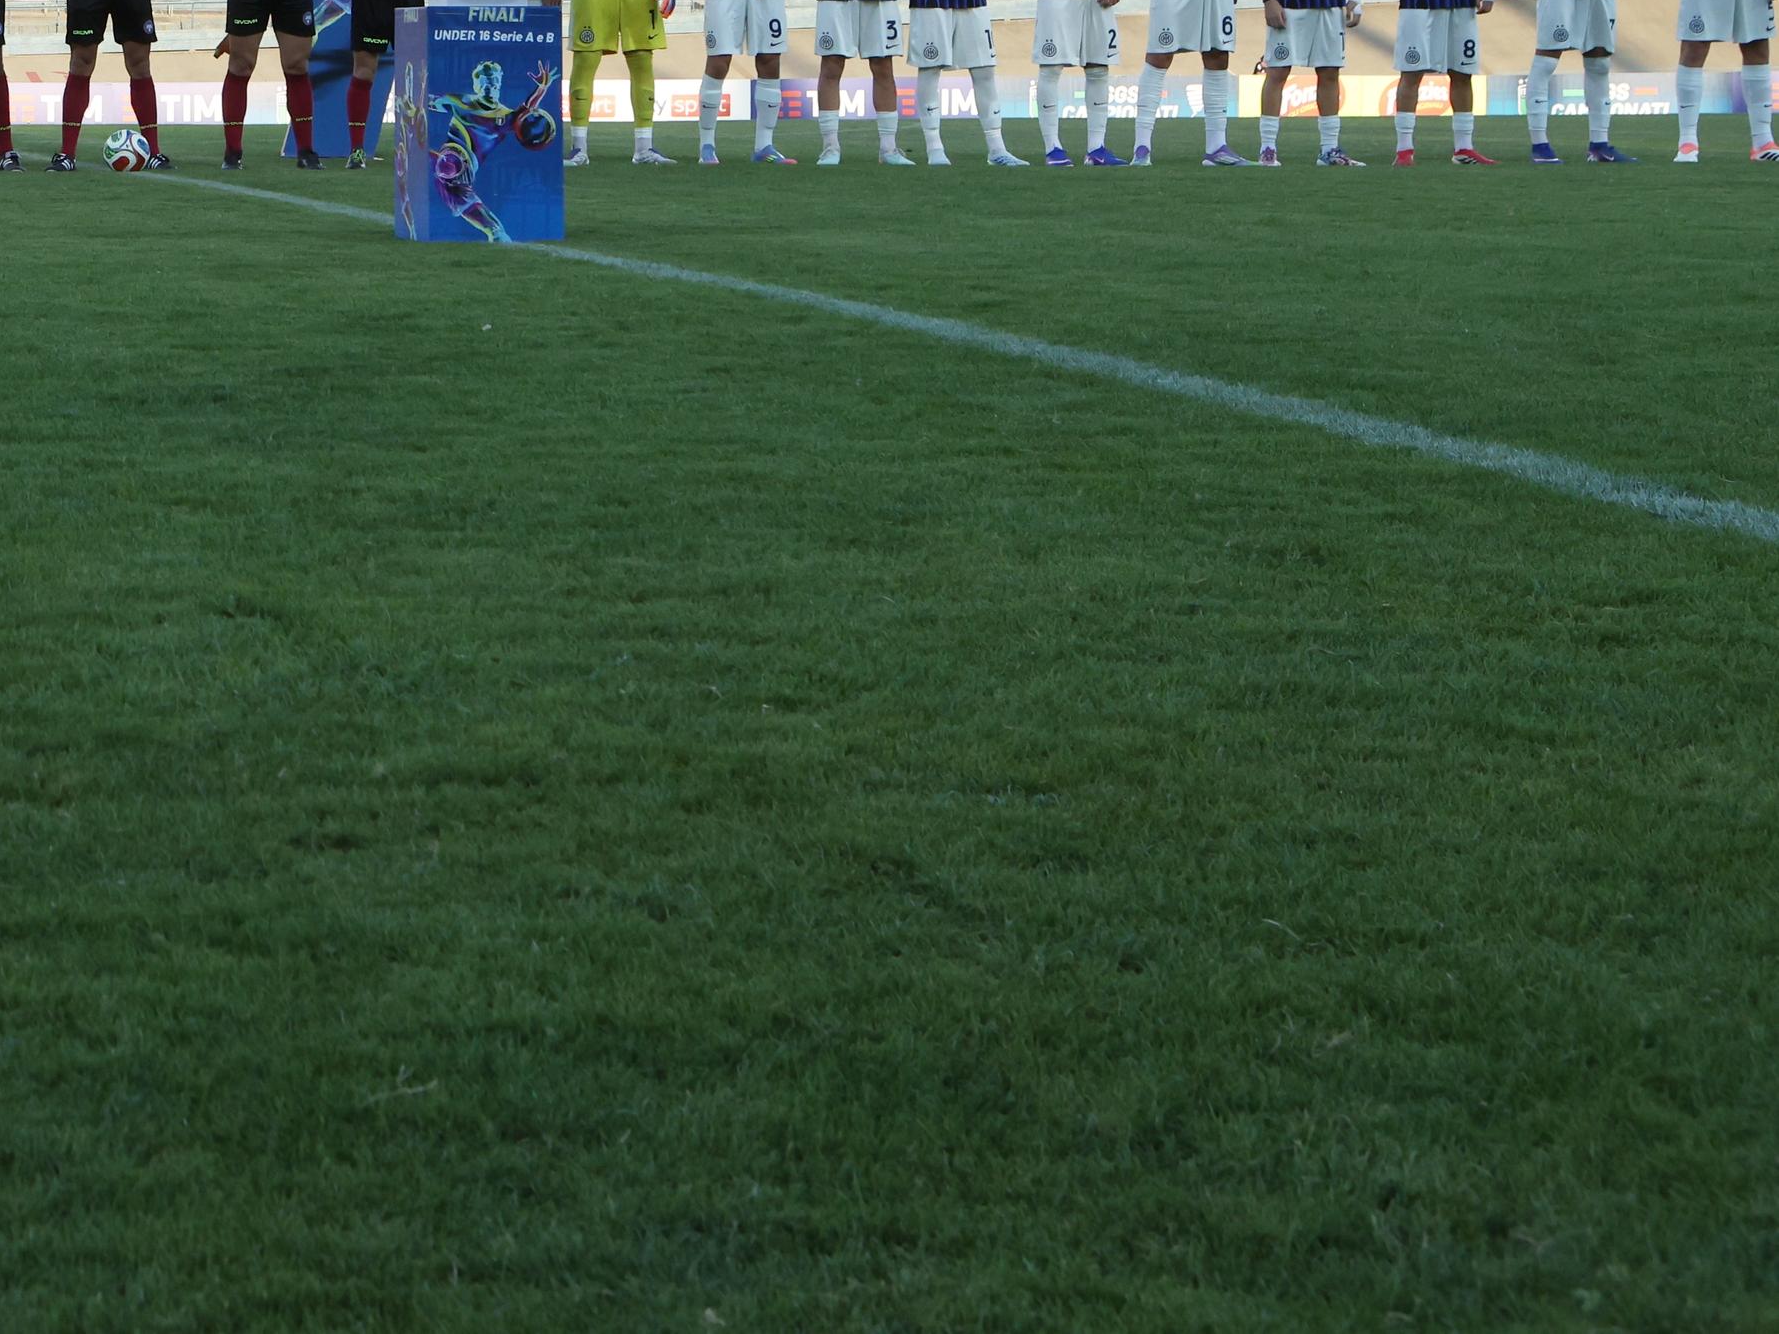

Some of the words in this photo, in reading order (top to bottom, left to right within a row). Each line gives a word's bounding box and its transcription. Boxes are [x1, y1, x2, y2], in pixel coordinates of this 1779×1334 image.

[468, 7, 525, 23] FINALI
[434, 29, 476, 41] UNDER
[478, 30, 490, 41] 16
[492, 31, 523, 42] Serie
[525, 32, 534, 43] A
[536, 34, 544, 43] e
[546, 32, 555, 43] B
[769, 18, 782, 39] 9
[886, 20, 898, 41] 3
[1222, 16, 1234, 36] 6
[1108, 29, 1117, 50] 2
[1463, 39, 1476, 59] 8
[161, 94, 223, 122] TIM
[806, 89, 865, 117] TM
[940, 88, 979, 116] IM
